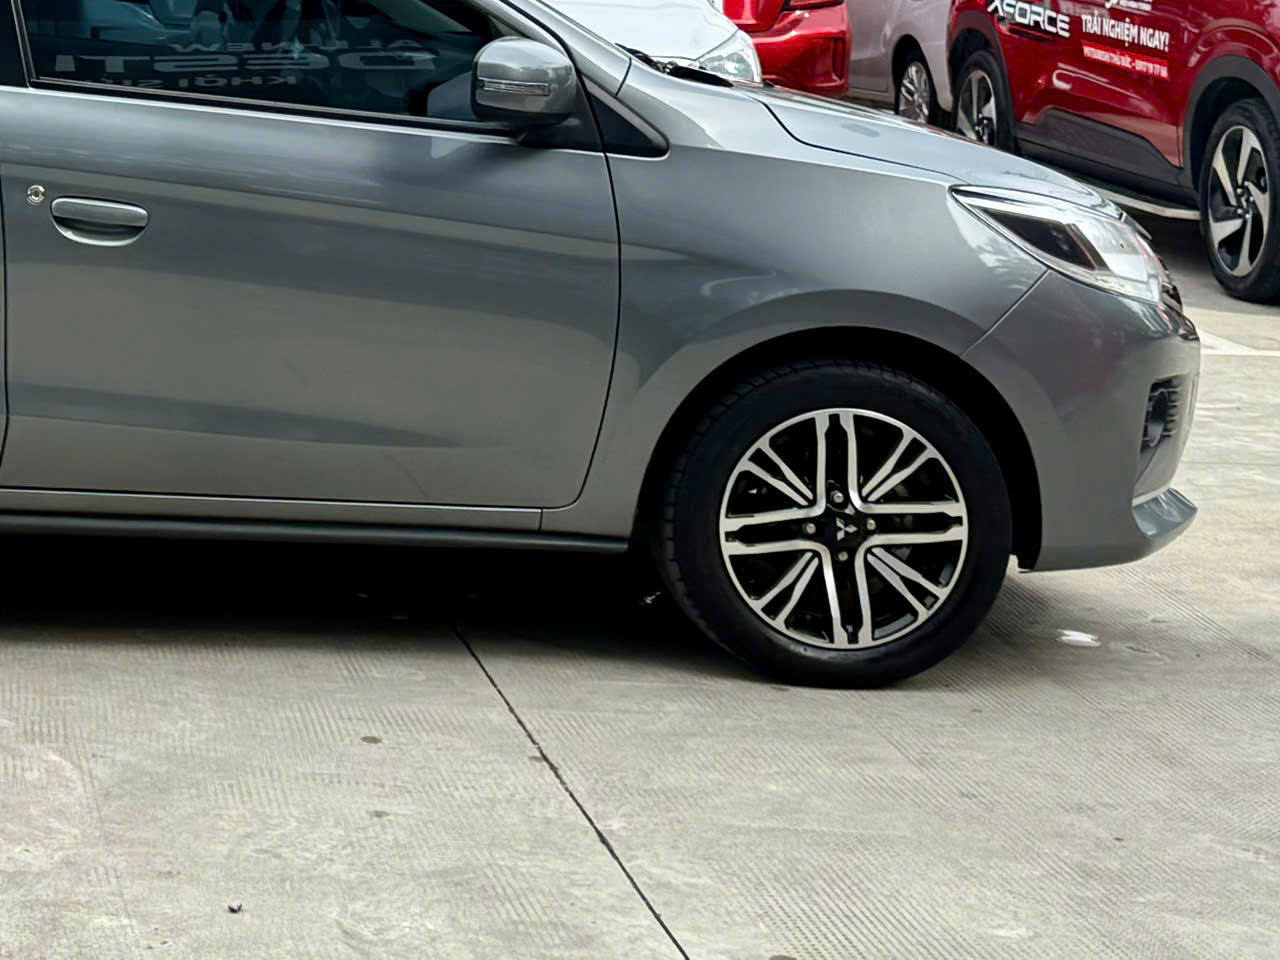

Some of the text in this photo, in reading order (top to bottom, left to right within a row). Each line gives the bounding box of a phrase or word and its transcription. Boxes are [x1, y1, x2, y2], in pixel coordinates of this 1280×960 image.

[1081, 9, 1170, 53] TRẢI NGHIỆM NGAY!
